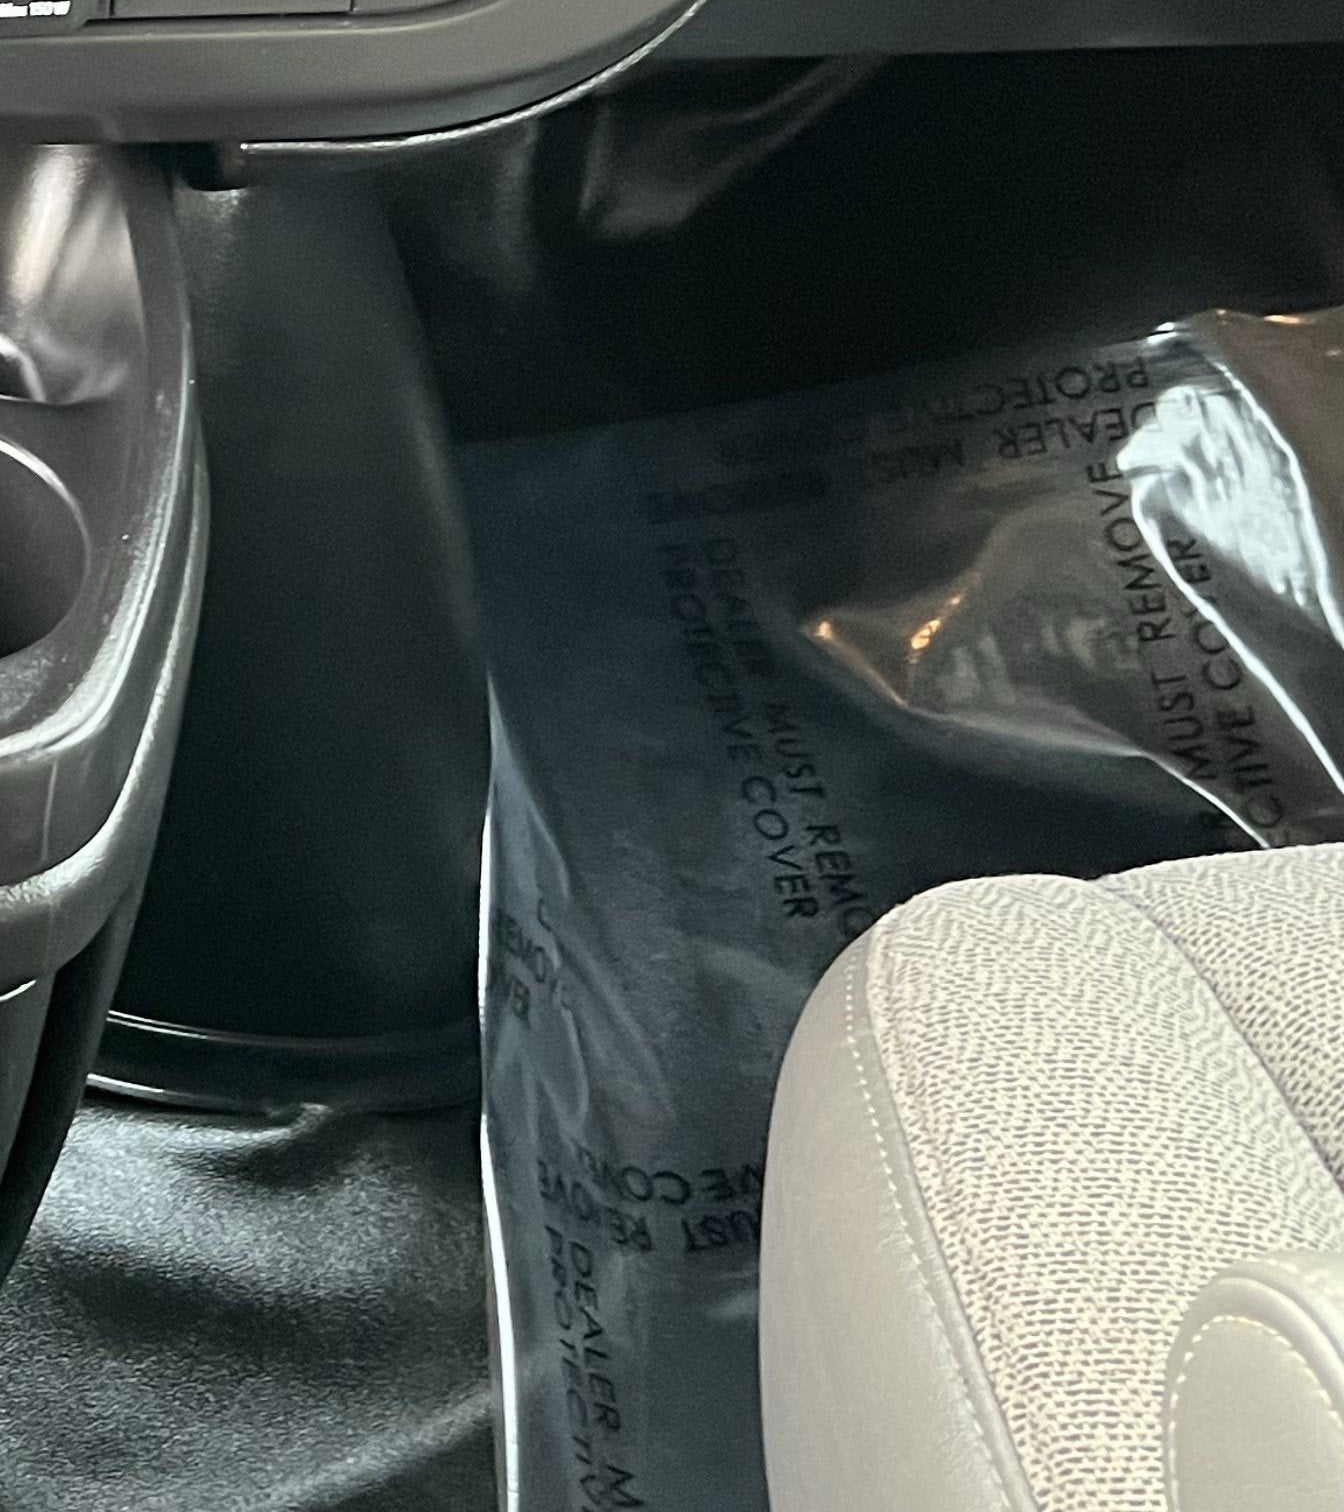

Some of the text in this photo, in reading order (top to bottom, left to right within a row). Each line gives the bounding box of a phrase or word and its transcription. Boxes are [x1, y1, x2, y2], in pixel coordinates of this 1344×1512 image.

[765, 701, 826, 800] MUST
[1150, 669, 1218, 781] MUST
[739, 774, 819, 920] COVER
[569, 1239, 623, 1434] DEALER
